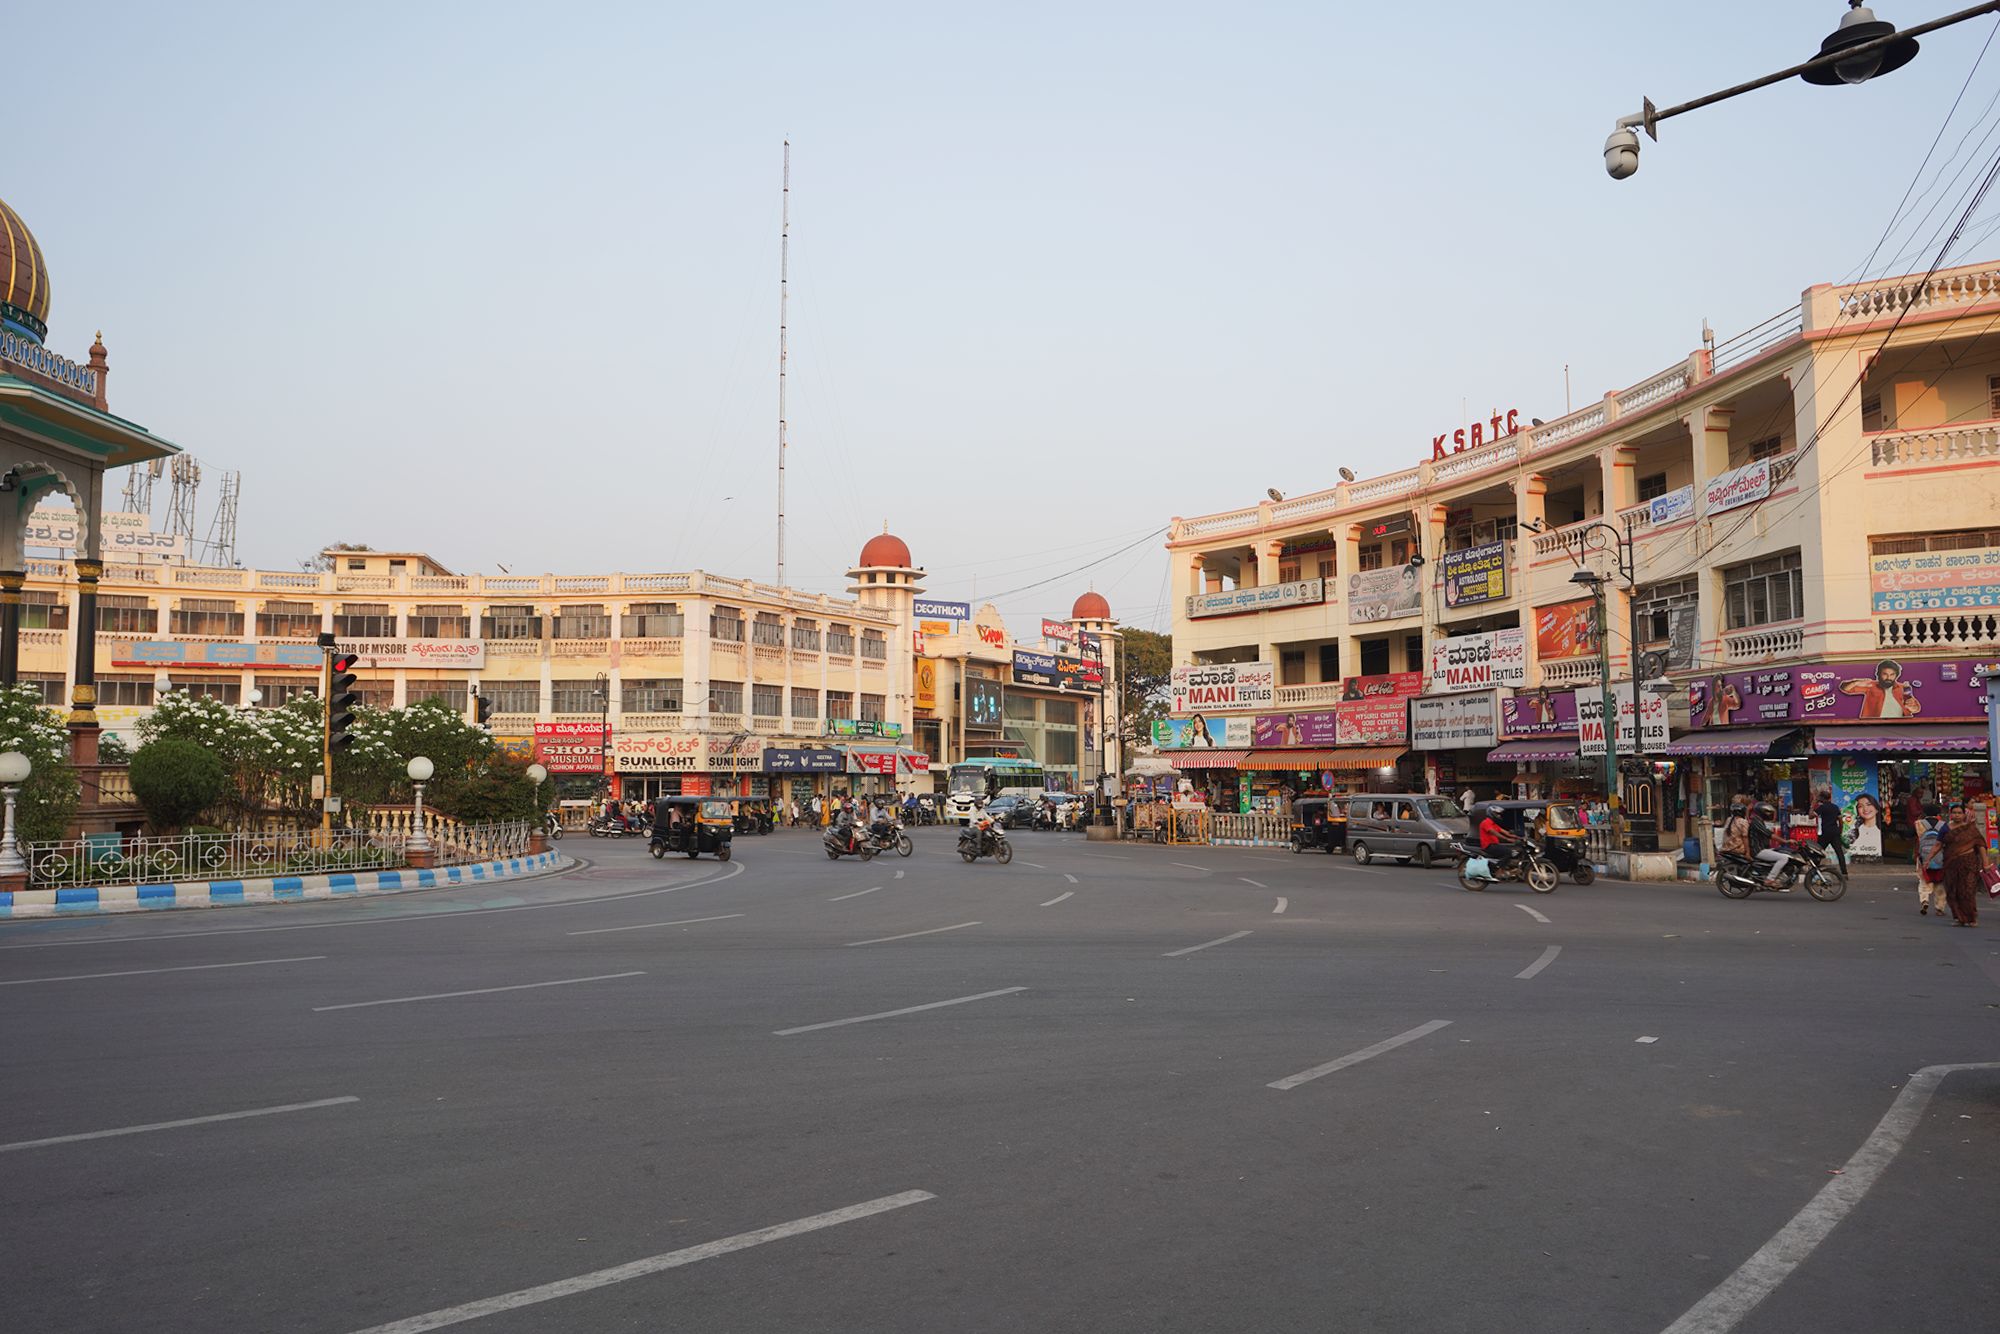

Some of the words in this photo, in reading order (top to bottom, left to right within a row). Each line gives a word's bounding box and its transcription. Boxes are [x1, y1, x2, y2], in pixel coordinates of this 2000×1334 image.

[1432, 409, 1518, 462] KSRTC
[116, 530, 176, 548] ಭವನ
[1915, 555, 1942, 569] ವಾಹನ
[1946, 554, 1980, 566] ಚಾಲನಾ
[1458, 572, 1488, 586] ASTROLOGER
[916, 604, 965, 616] DECATHLON
[335, 644, 357, 654] STAR
[358, 644, 370, 654] OF
[372, 643, 407, 654] MYSORE
[1448, 640, 1491, 666] ಮಾಣಿ
[1189, 667, 1236, 686] ಮಾಣಿ
[1434, 670, 1446, 679] OLD
[1446, 665, 1490, 685] MANI
[1492, 668, 1524, 681] TEXTILES
[1969, 676, 1980, 687] &
[1172, 687, 1186, 696] OLD
[1189, 686, 1236, 704] MANI
[1238, 690, 1272, 700] TEXTILES
[1806, 683, 1830, 695] CAMPA
[1356, 712, 1378, 720] MYSURU
[1414, 732, 1436, 740] MYSORE
[1437, 730, 1450, 738] CITY
[1464, 727, 1494, 738] TERMINAL
[1582, 721, 1620, 742] MAI
[542, 746, 602, 754] SHOE
[550, 756, 594, 764] MUSEUM
[620, 756, 696, 766] SUNLIGHT
